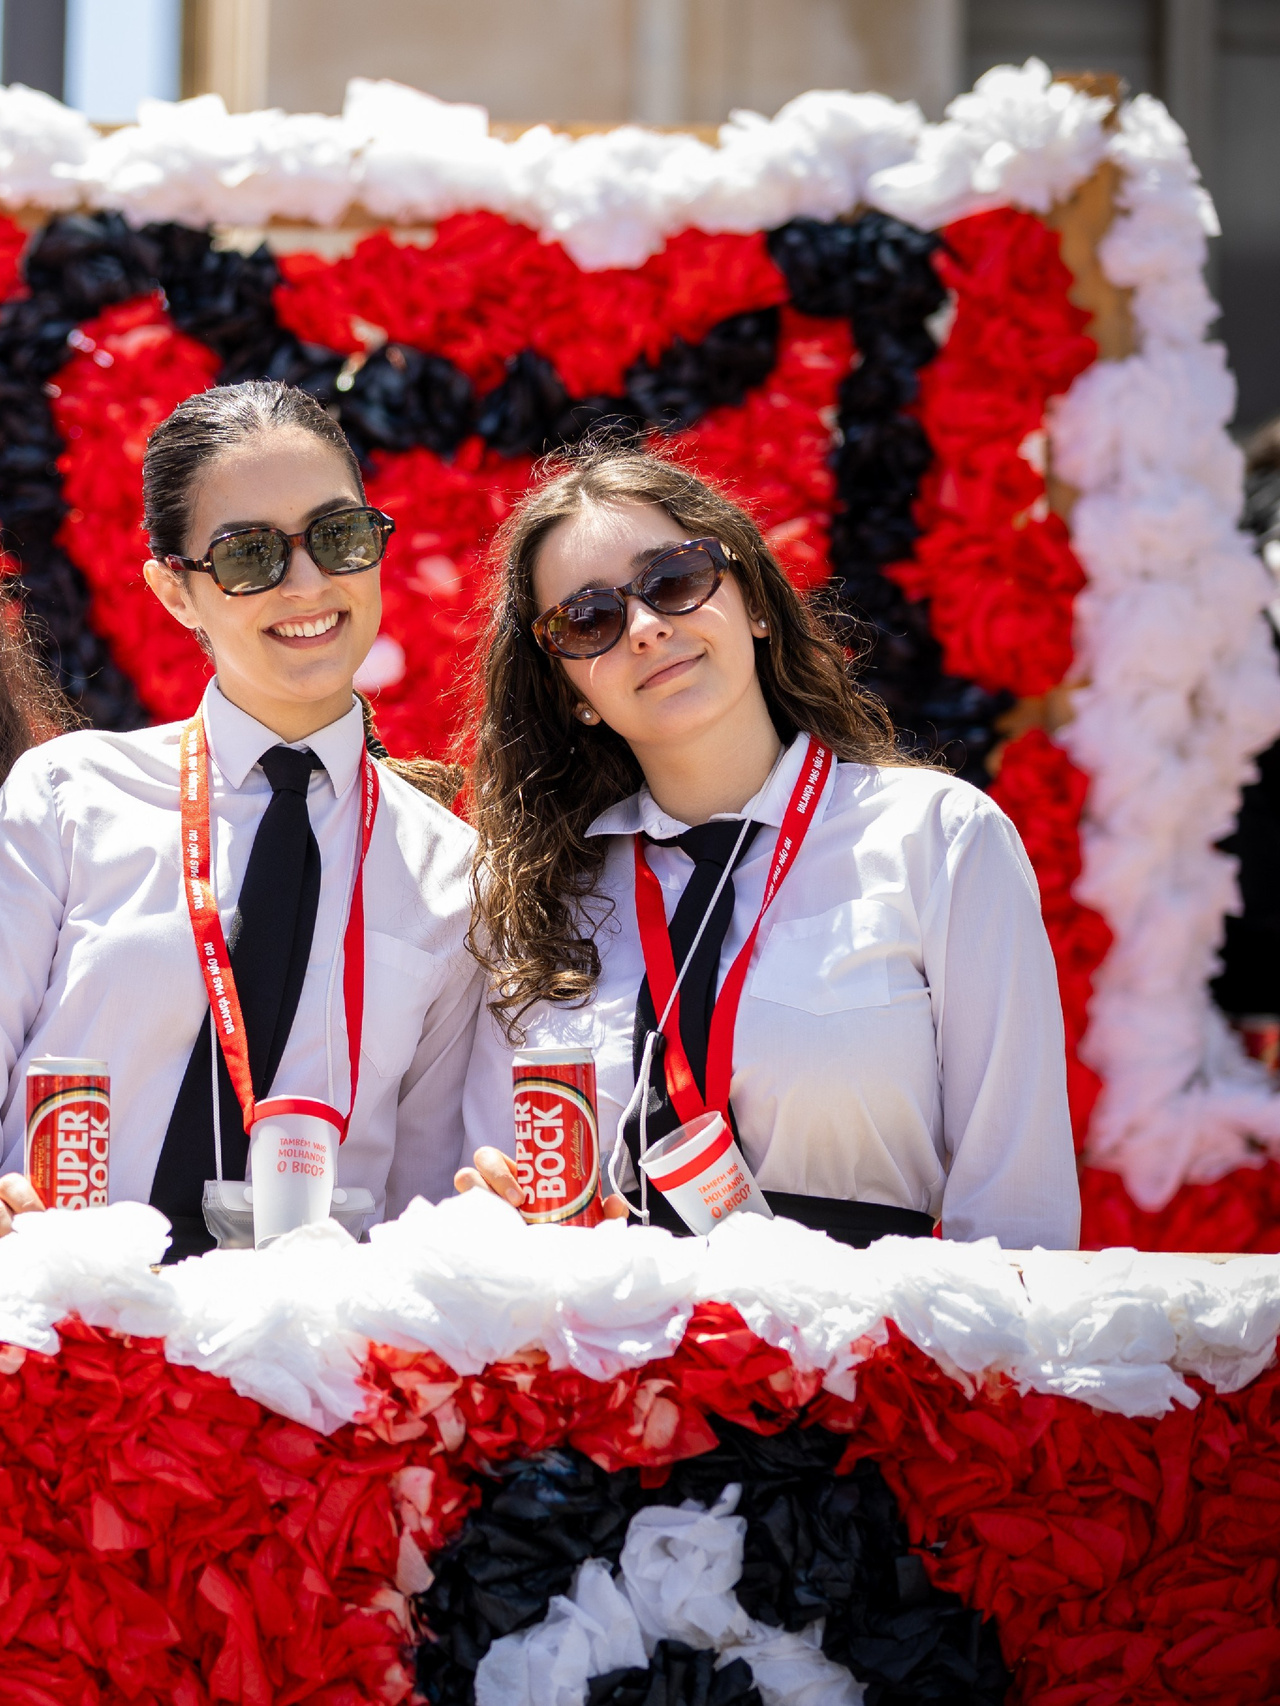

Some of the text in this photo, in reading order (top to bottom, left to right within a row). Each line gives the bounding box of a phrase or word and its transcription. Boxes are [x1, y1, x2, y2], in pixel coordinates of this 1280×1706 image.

[812, 756, 824, 770] NÃO
[808, 768, 820, 785] MAS
[796, 784, 815, 814] BALANÇA
[188, 829, 198, 842] CAI
[187, 843, 199, 858] NÃO
[778, 848, 788, 867] NÃO
[784, 836, 792, 850] CAI
[190, 860, 199, 878] MAS
[204, 942, 235, 1034] BALANÇA MAS NÃO CAI
[278, 1148, 326, 1164] MOLHANDO
[313, 1142, 326, 1153] VAIS
[514, 1100, 536, 1204] SUPER
[532, 1103, 567, 1198] BOCK
[56, 1110, 90, 1210] SUPER
[89, 1116, 109, 1208] BOCK
[277, 1160, 324, 1178] O BICO?
[726, 1162, 739, 1176] VAIS
[703, 1172, 744, 1206] MOLHANDO
[711, 1183, 752, 1218] O BICO?
